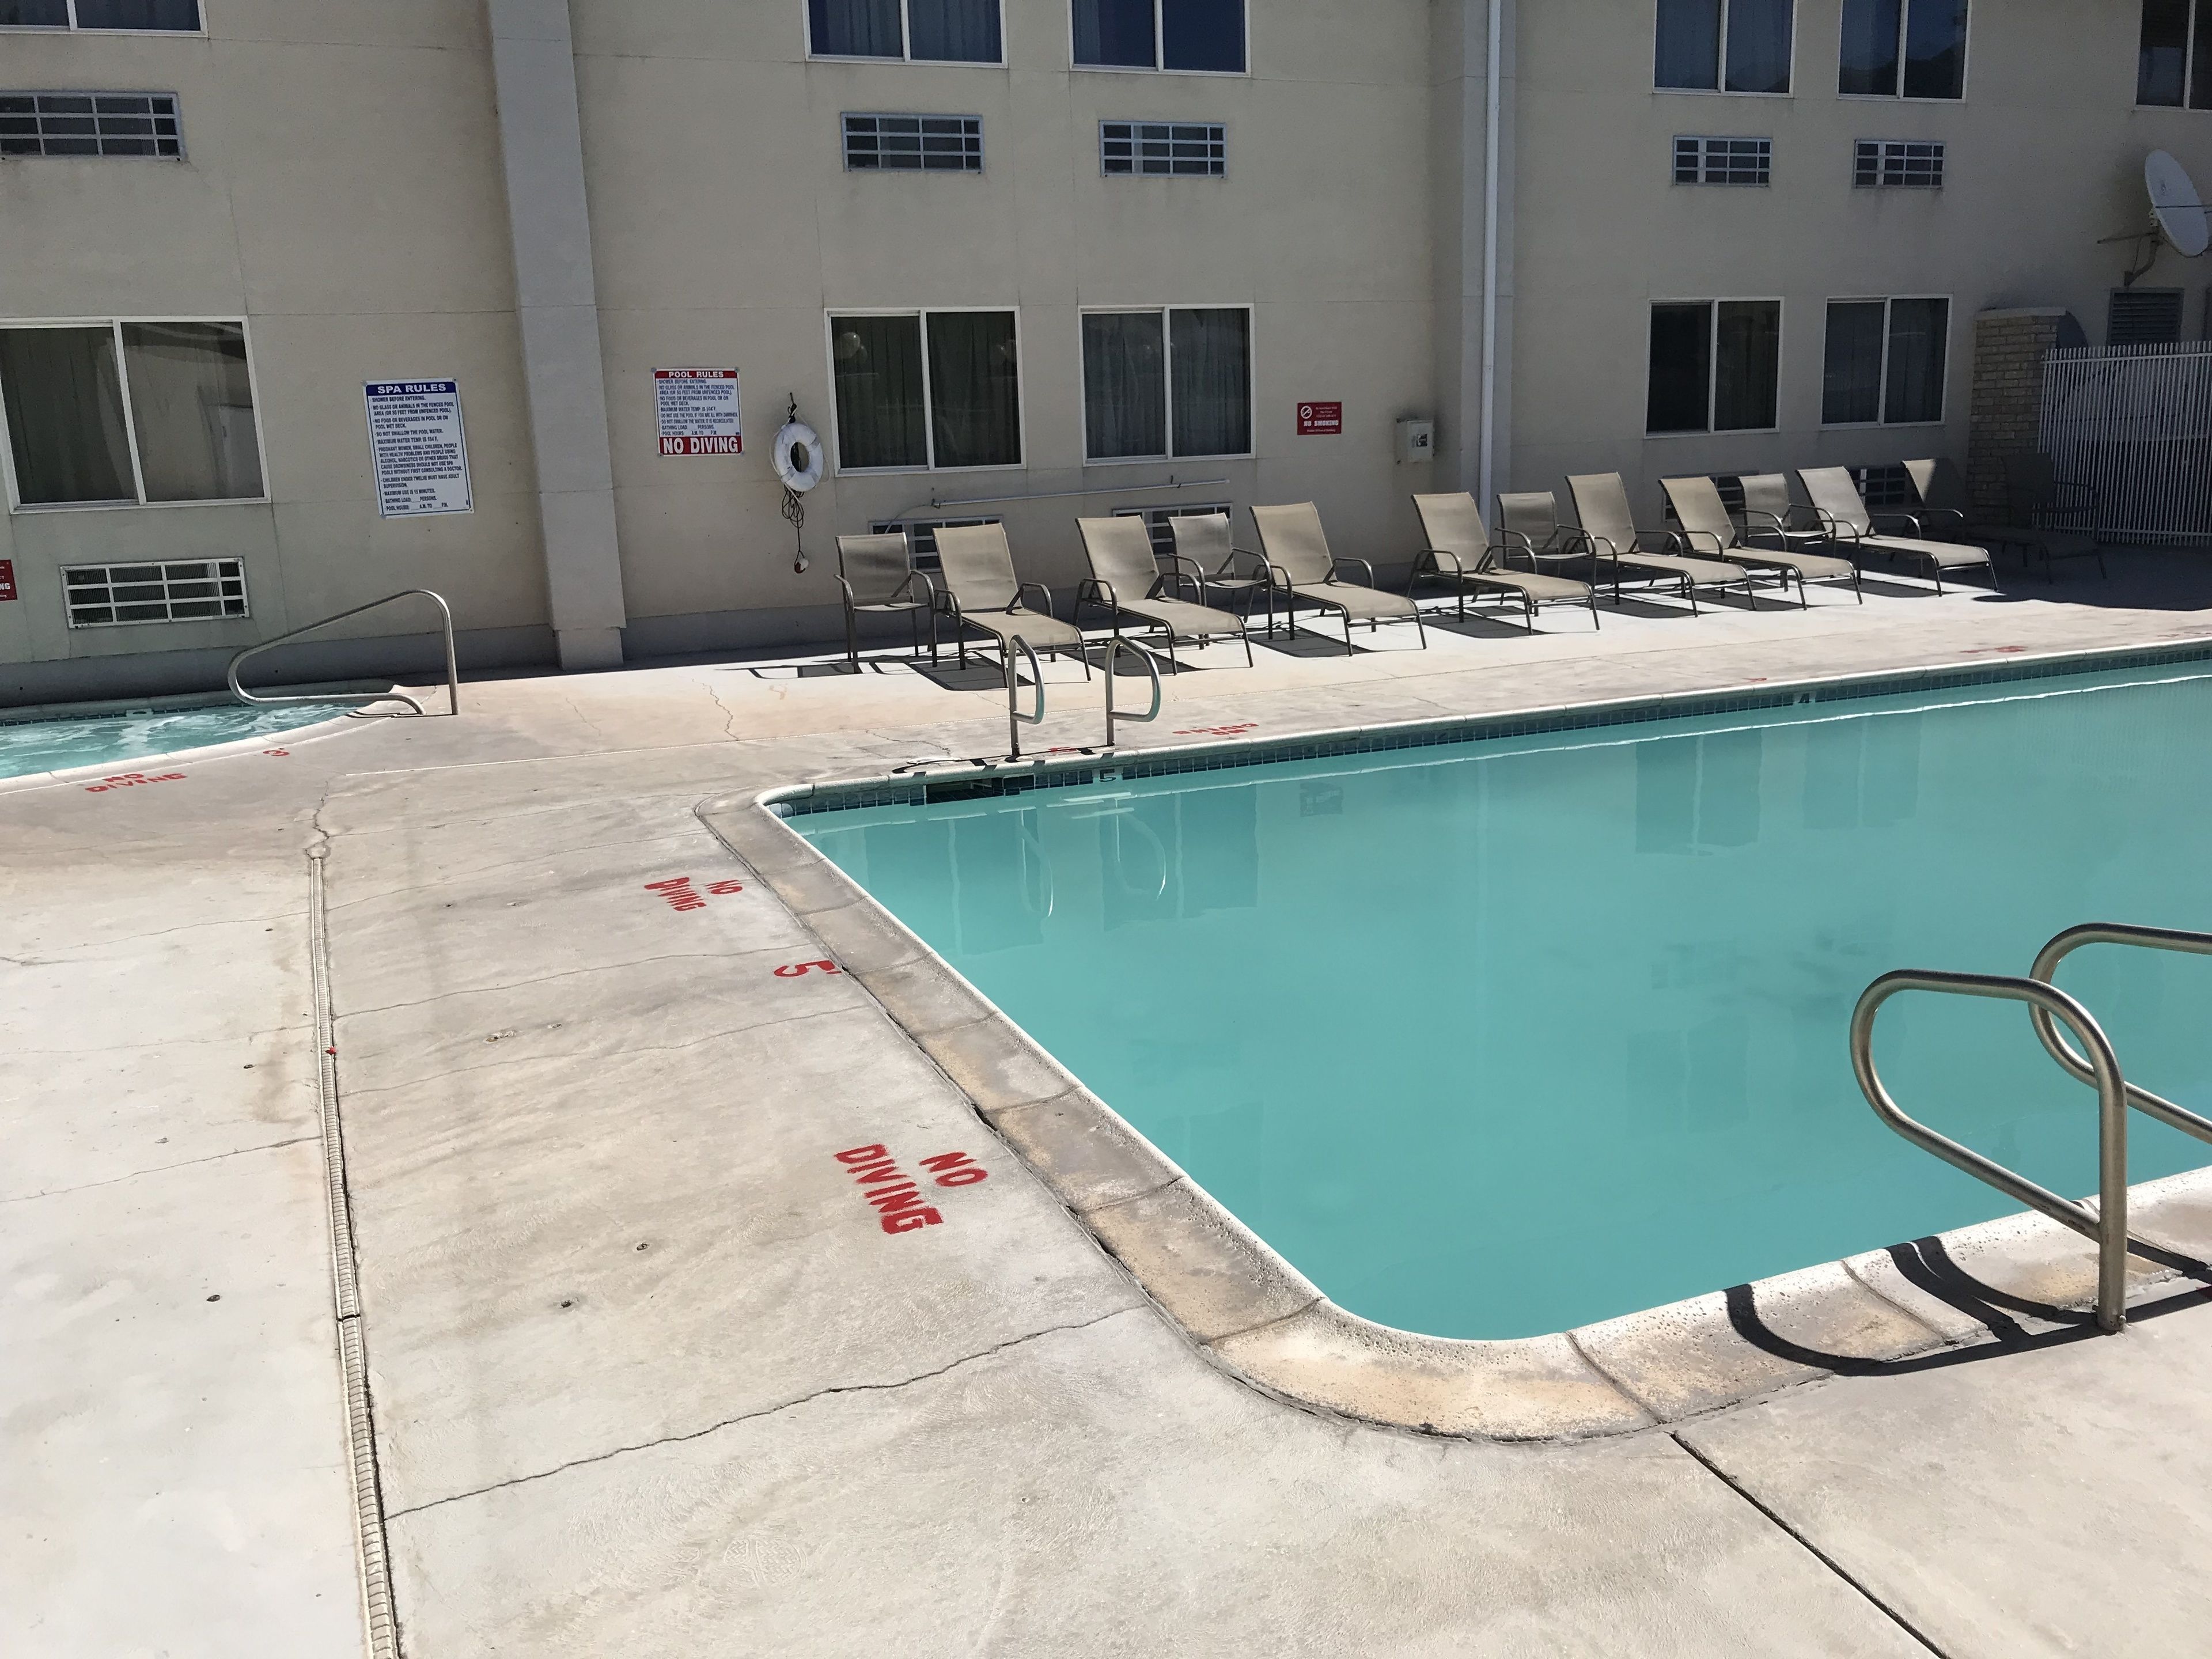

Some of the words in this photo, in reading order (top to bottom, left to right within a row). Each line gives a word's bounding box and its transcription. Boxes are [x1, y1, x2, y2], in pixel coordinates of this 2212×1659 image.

[378, 385, 402, 393] SPA
[406, 384, 446, 392] RULES
[664, 438, 684, 454] NO
[690, 437, 738, 453] DIVING
[85, 773, 187, 792] DIVING
[102, 774, 143, 782] NO
[644, 877, 707, 912] DIVING
[703, 879, 743, 894] NO
[919, 1152, 988, 1187] NO
[834, 1143, 944, 1234] DIVING
